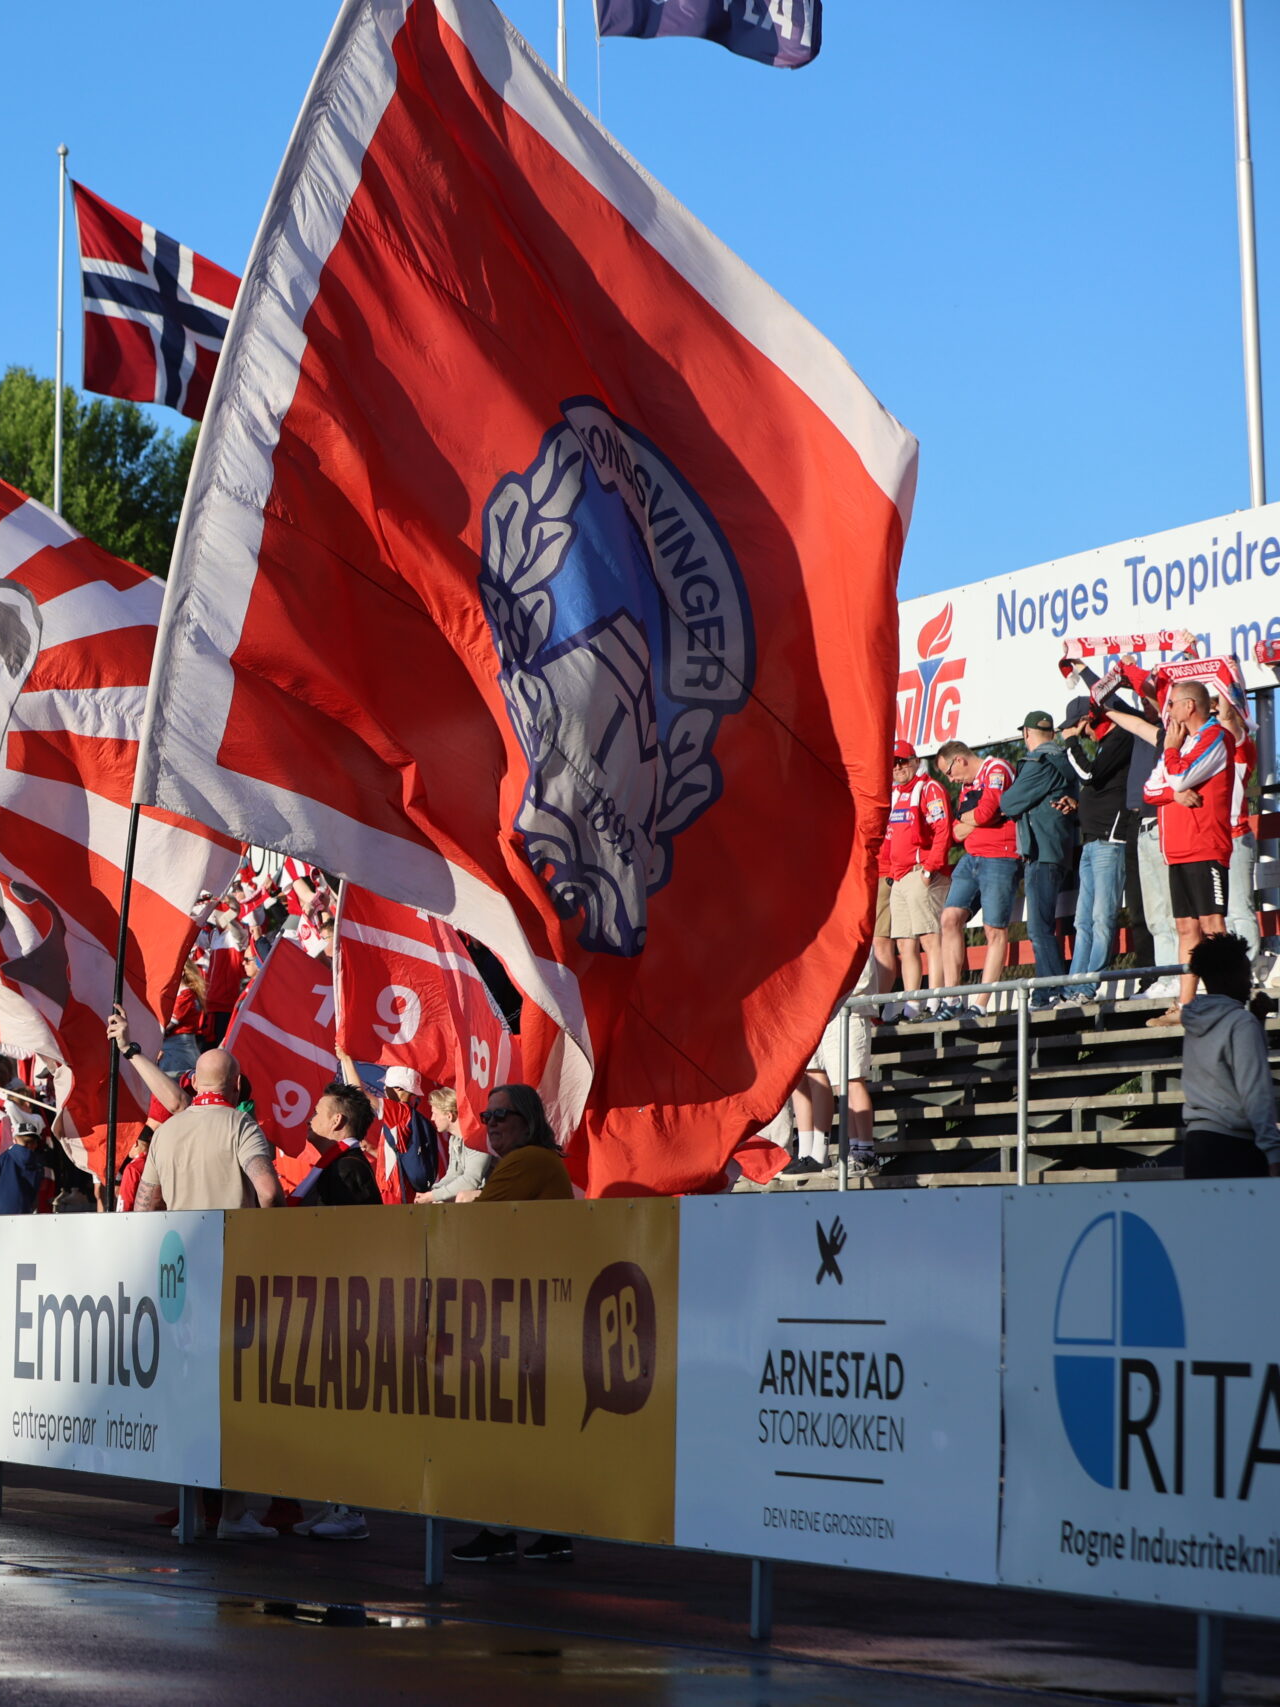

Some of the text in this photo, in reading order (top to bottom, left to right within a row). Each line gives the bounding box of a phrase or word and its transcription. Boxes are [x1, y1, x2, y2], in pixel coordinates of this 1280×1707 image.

[723, 0, 813, 47] LAY
[996, 531, 1280, 641] Norges Toppidre
[579, 786, 634, 866] 1892
[372, 984, 421, 1045] 9
[271, 1079, 312, 1129] 9
[233, 1275, 548, 1427] PIZZABAKEREN
[759, 1349, 904, 1400] ARNESTAD
[12, 1405, 158, 1452] entreprenør interiør
[758, 1408, 904, 1453] STORKJØKKEN
[1119, 1357, 1280, 1500] RITA
[763, 1507, 894, 1540] DEN RENE GROSSISTEN
[1060, 1519, 1125, 1567] Rogne
